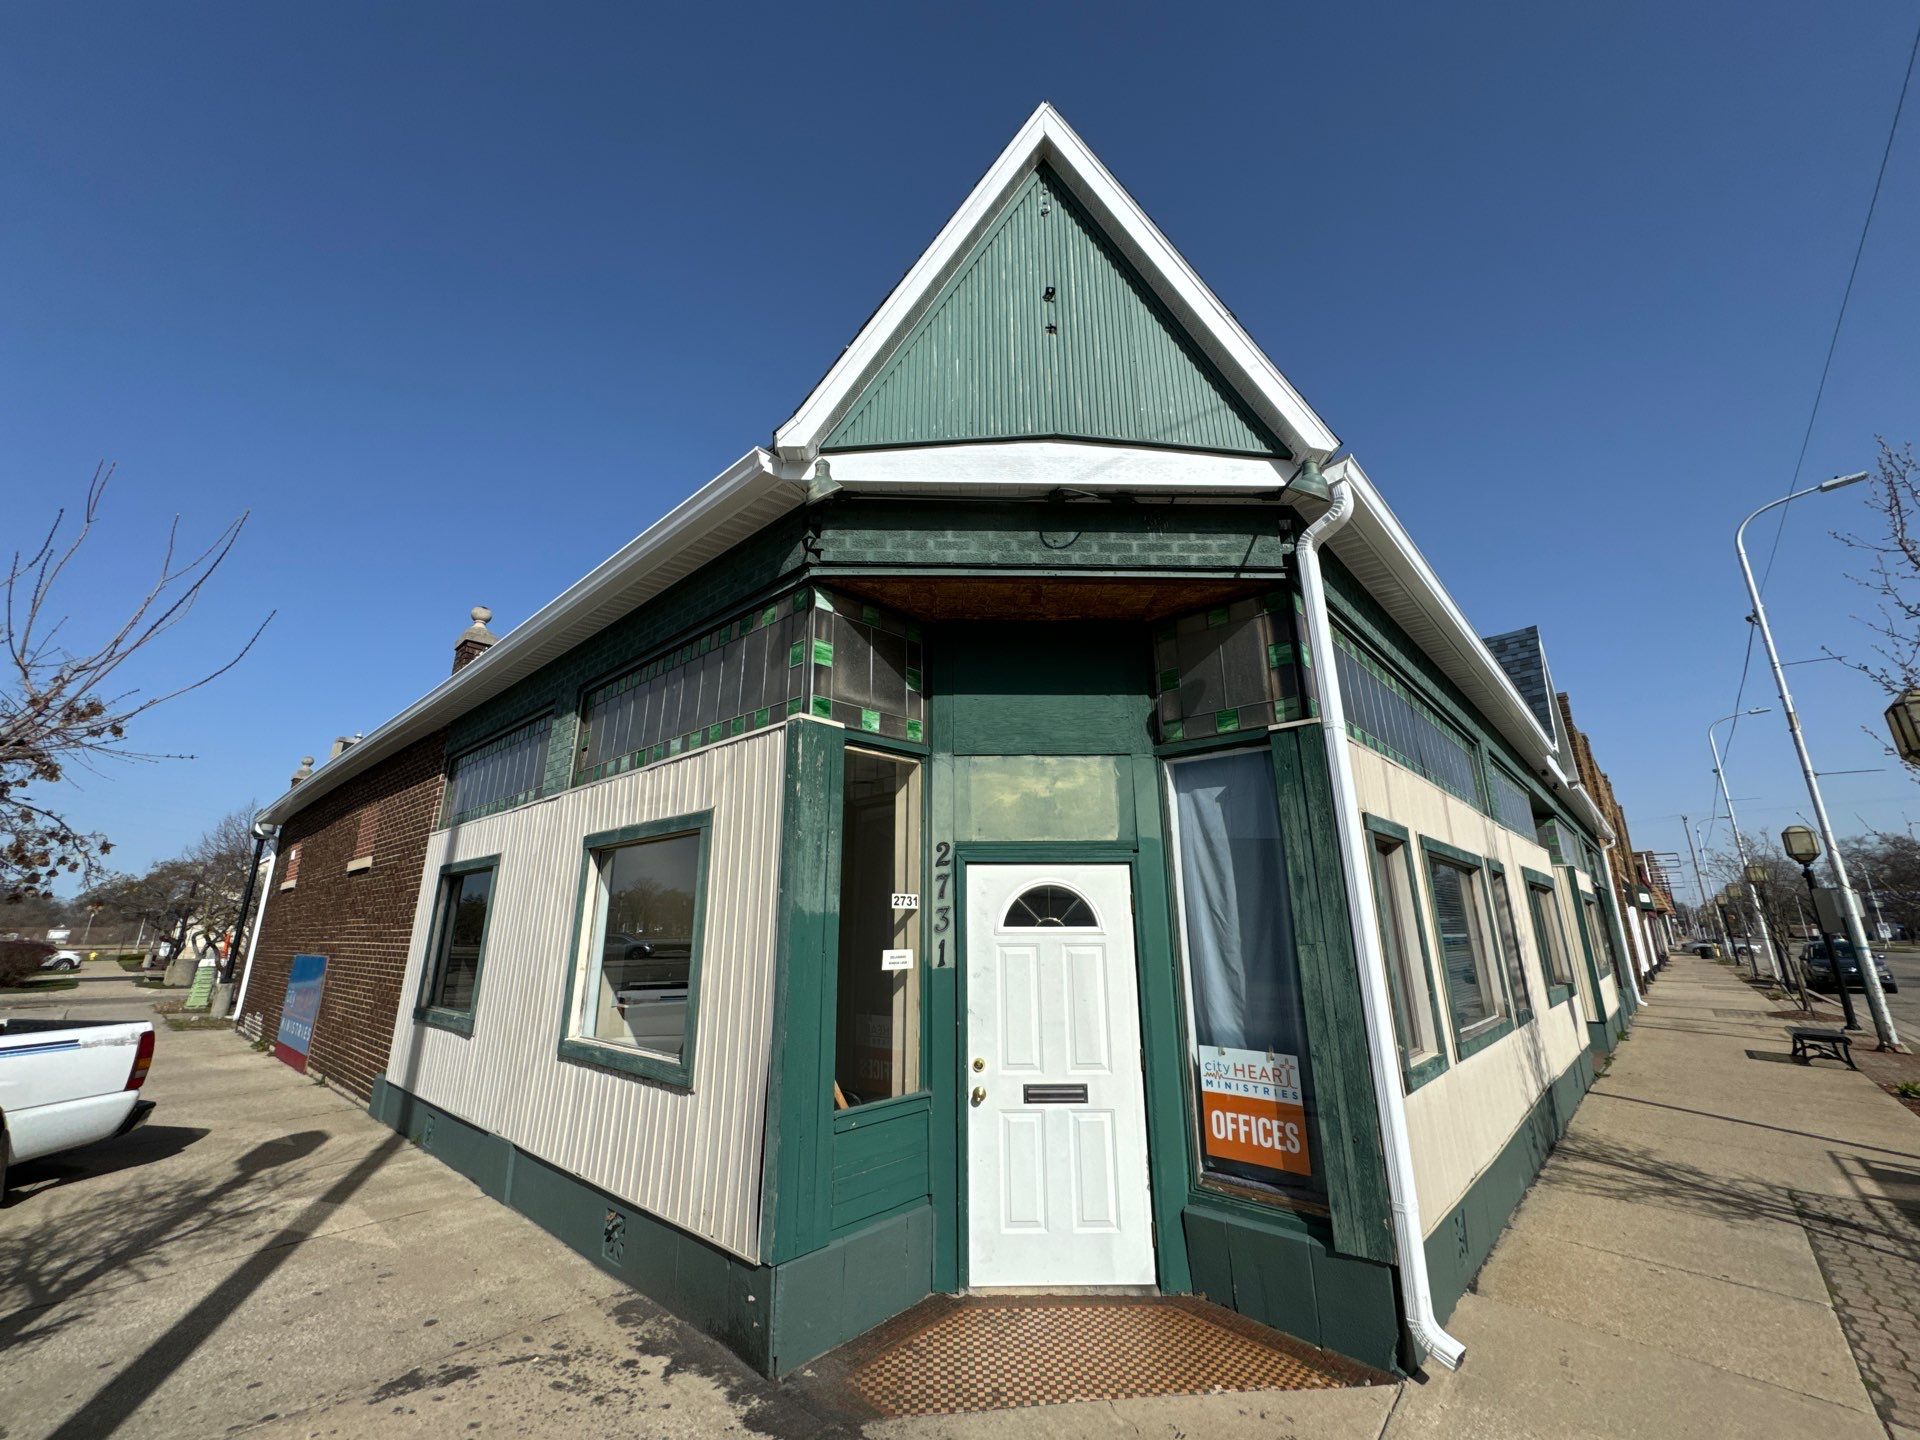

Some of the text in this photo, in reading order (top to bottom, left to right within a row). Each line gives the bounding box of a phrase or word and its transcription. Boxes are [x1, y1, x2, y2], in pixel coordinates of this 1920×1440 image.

[894, 896, 918, 907] 2731
[935, 841, 951, 967] 2731
[1204, 1058, 1297, 1089] city HEART
[1206, 1079, 1298, 1100] MINISTRIES
[1211, 1109, 1301, 1154] OFFICES
